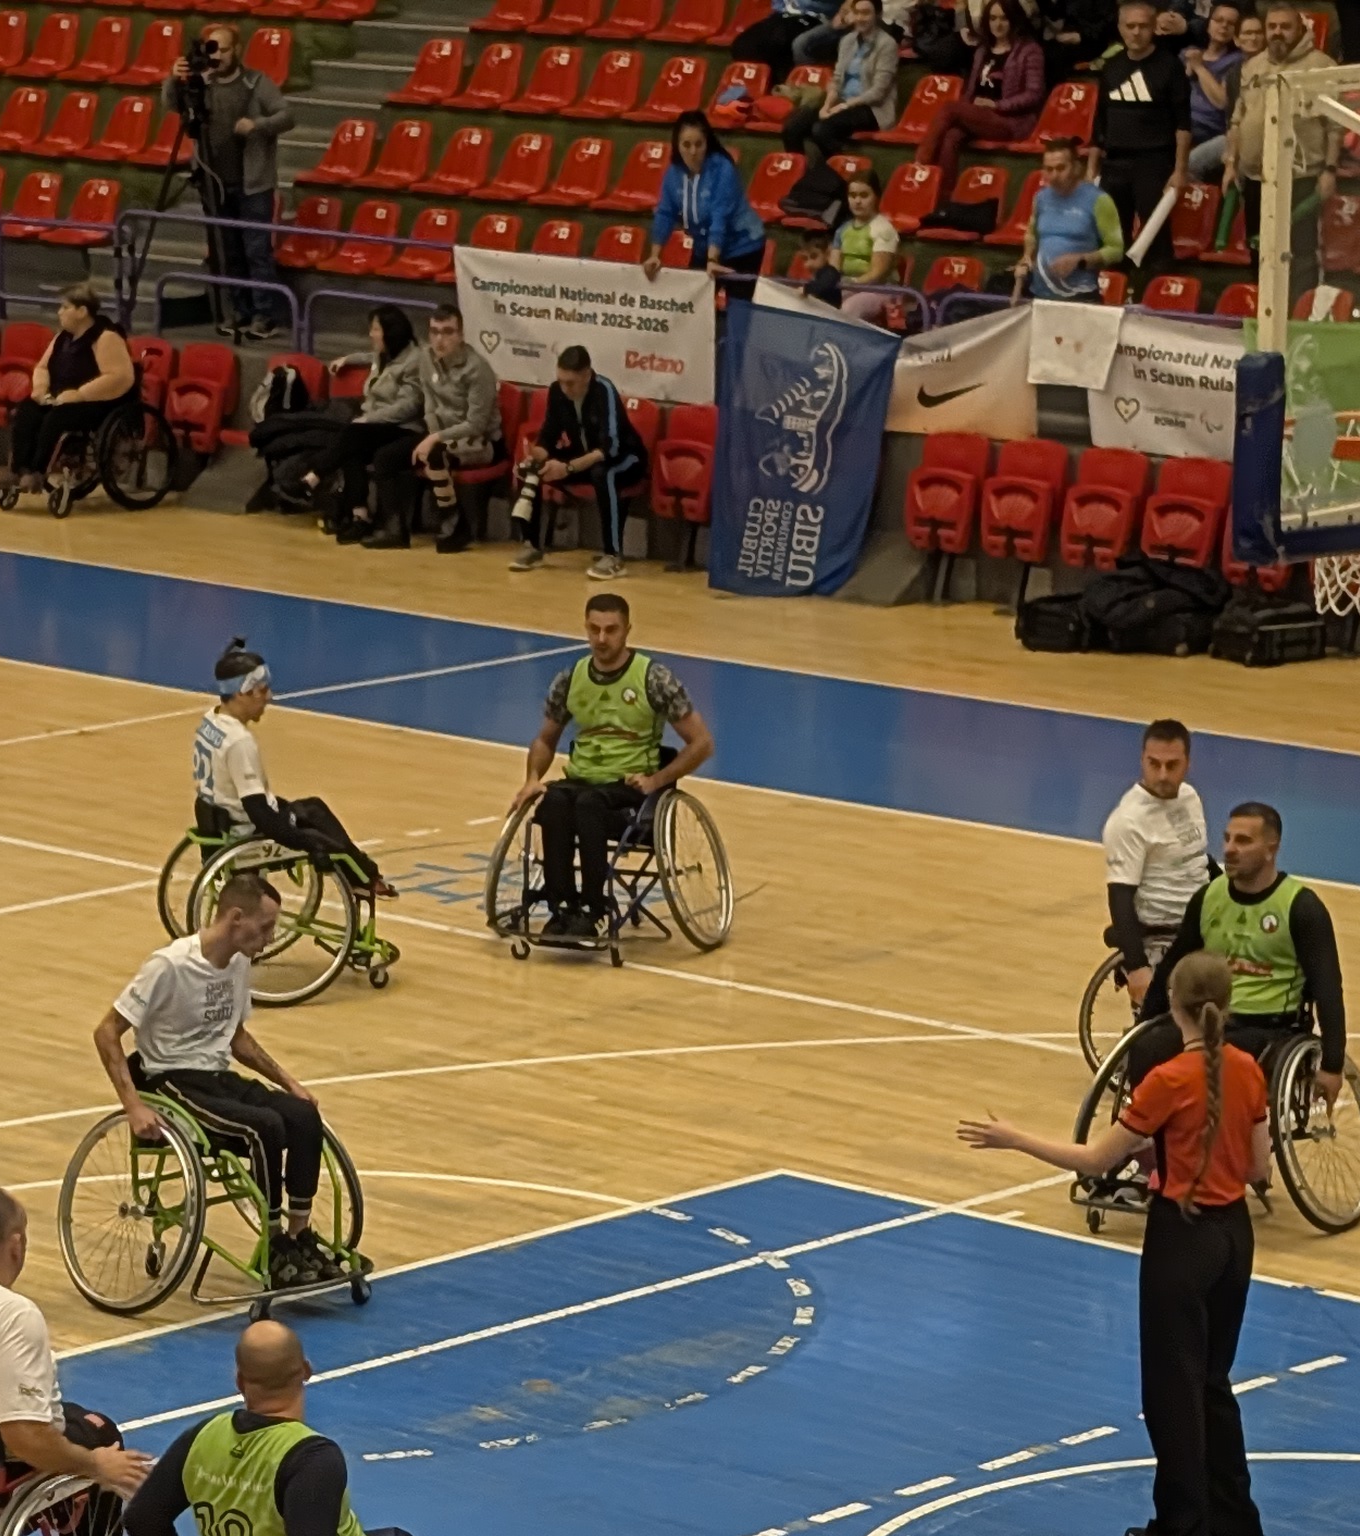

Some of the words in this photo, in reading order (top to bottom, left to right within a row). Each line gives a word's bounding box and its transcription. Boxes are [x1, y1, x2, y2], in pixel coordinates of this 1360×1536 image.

[472, 276, 556, 298] Campionatul
[619, 292, 635, 308] de
[640, 294, 695, 314] Baschet
[510, 302, 551, 320] Scaun
[555, 307, 598, 326] Rulant
[601, 312, 669, 333] 2025-2026
[625, 350, 684, 375] Betano
[1116, 343, 1208, 368] ampionatul
[1151, 371, 1195, 388] Scaun
[1199, 375, 1234, 393] Rula
